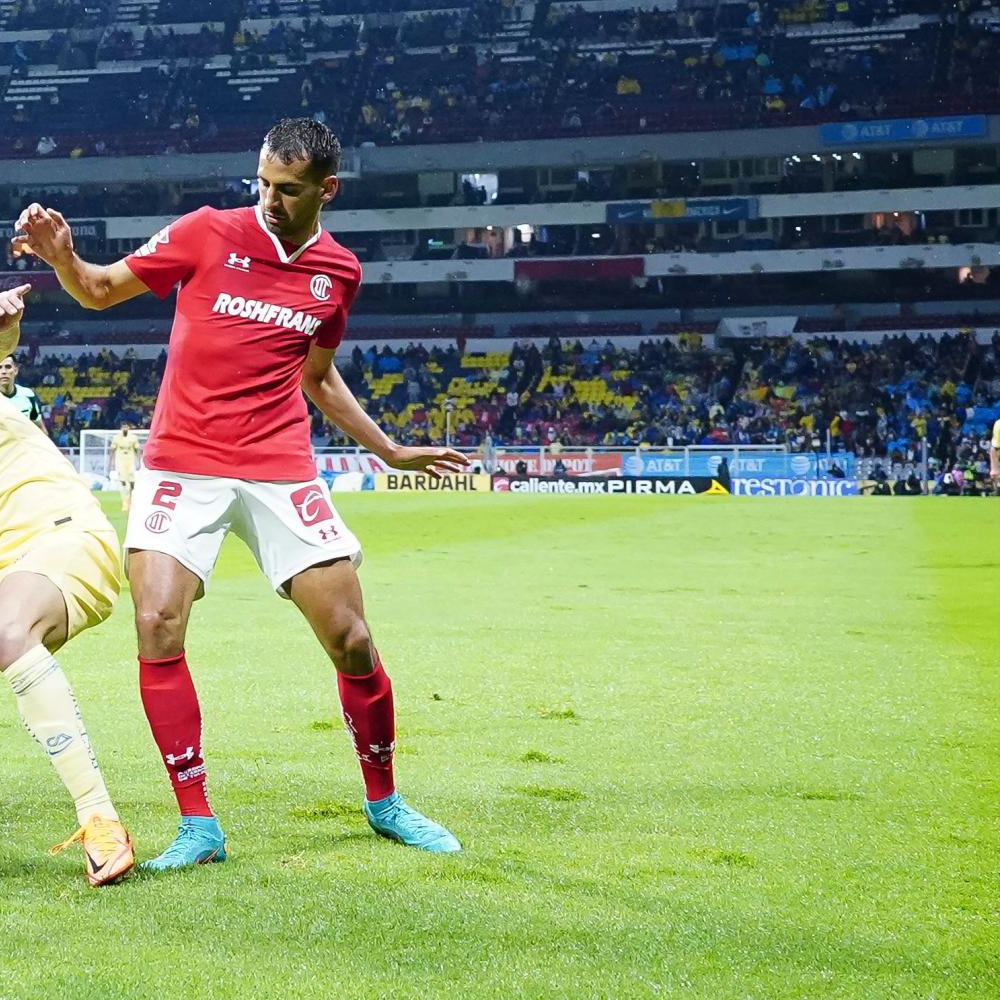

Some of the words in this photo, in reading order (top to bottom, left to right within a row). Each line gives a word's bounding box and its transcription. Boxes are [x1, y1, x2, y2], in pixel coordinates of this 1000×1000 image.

[646, 459, 682, 472] AT&T
[729, 459, 766, 472] AT&T
[387, 474, 477, 491] BARDAHL
[510, 477, 605, 494] caliente.mx
[608, 479, 696, 494] PIRMA
[151, 480, 182, 511] 2
